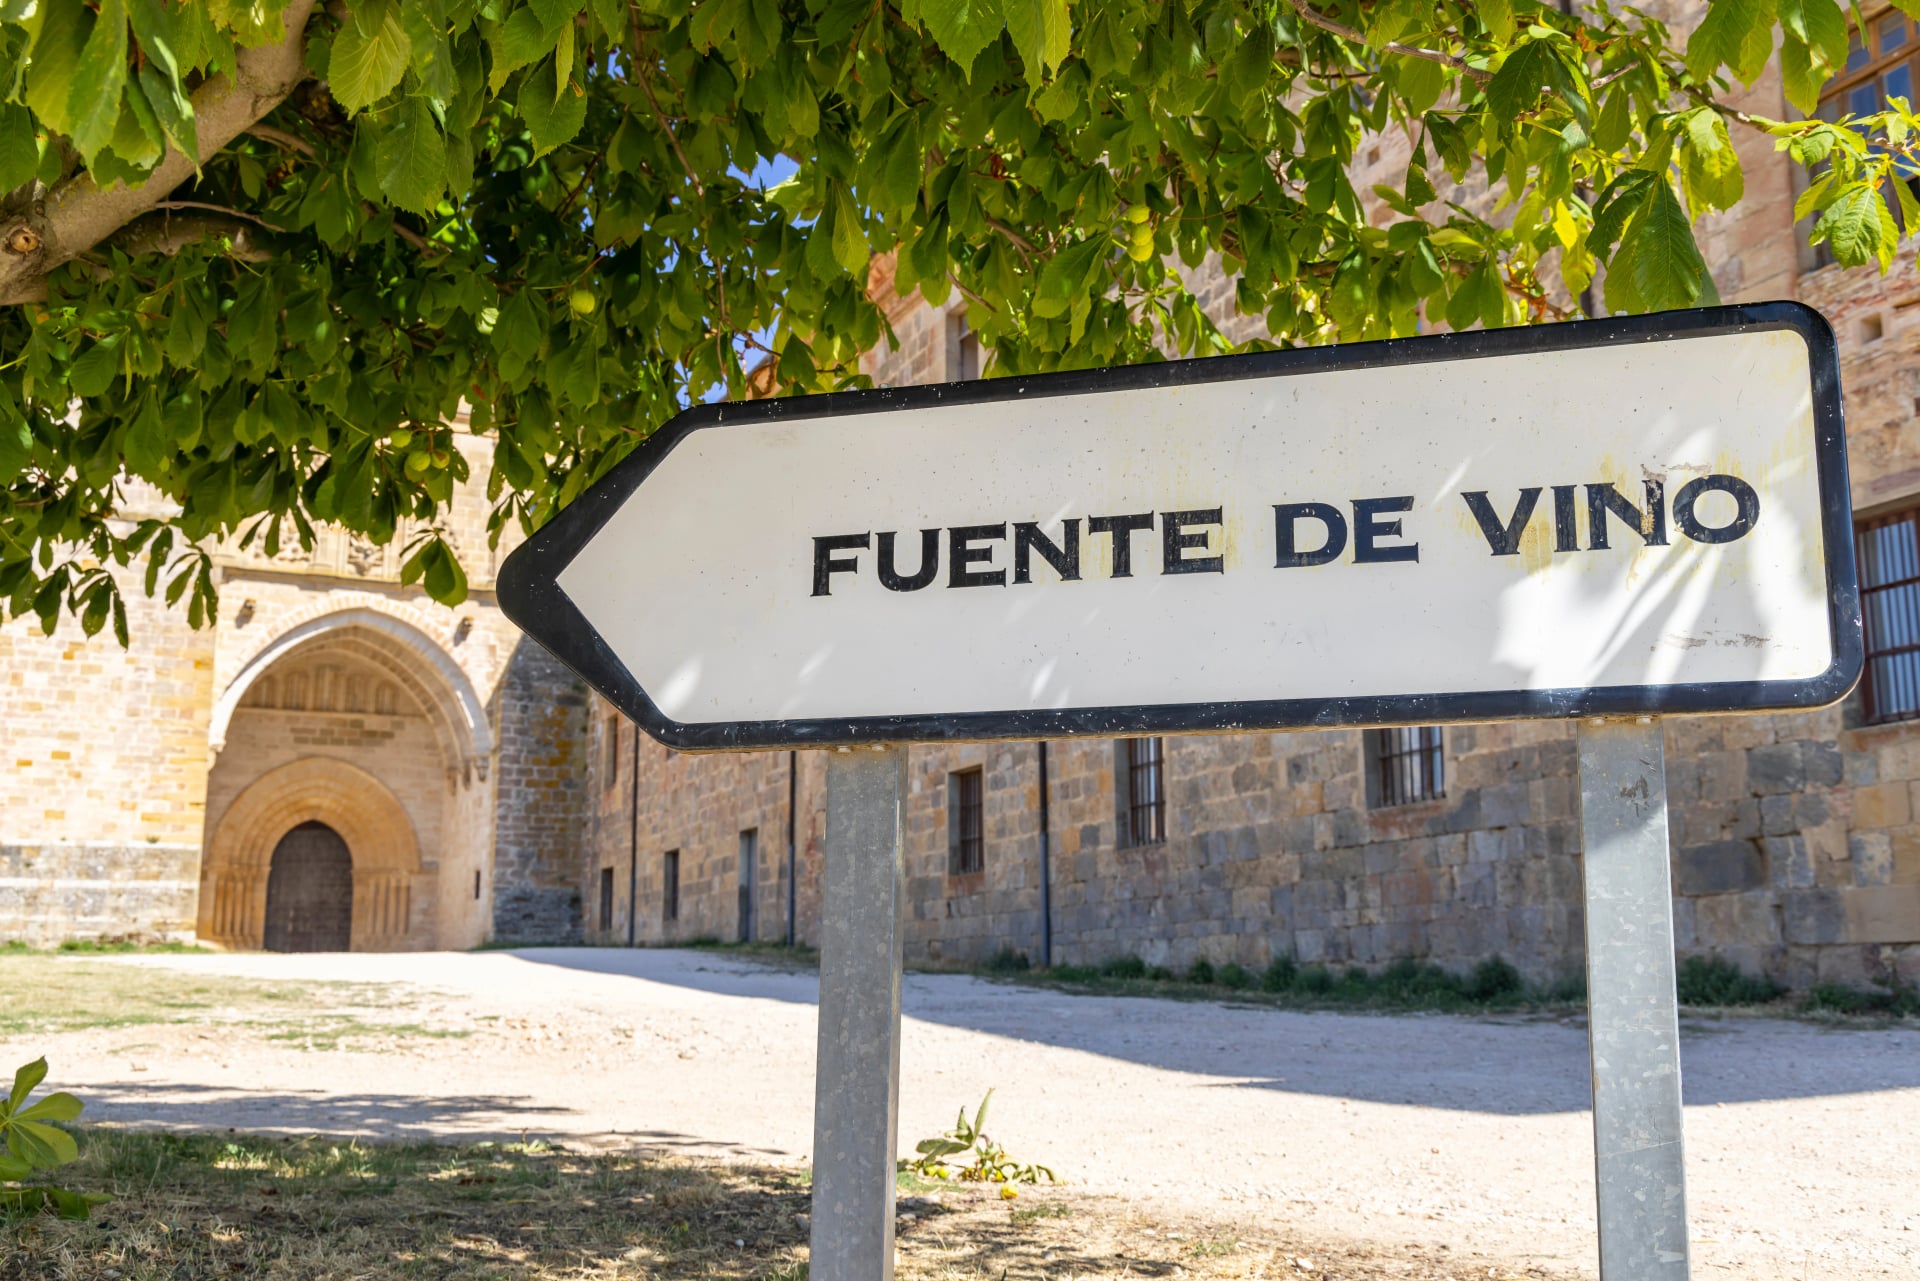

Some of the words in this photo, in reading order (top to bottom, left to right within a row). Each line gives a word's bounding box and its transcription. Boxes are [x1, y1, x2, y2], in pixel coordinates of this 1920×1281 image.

[810, 505, 1224, 597] FUENTE
[1271, 495, 1421, 569] DE
[1460, 474, 1760, 556] VINO
